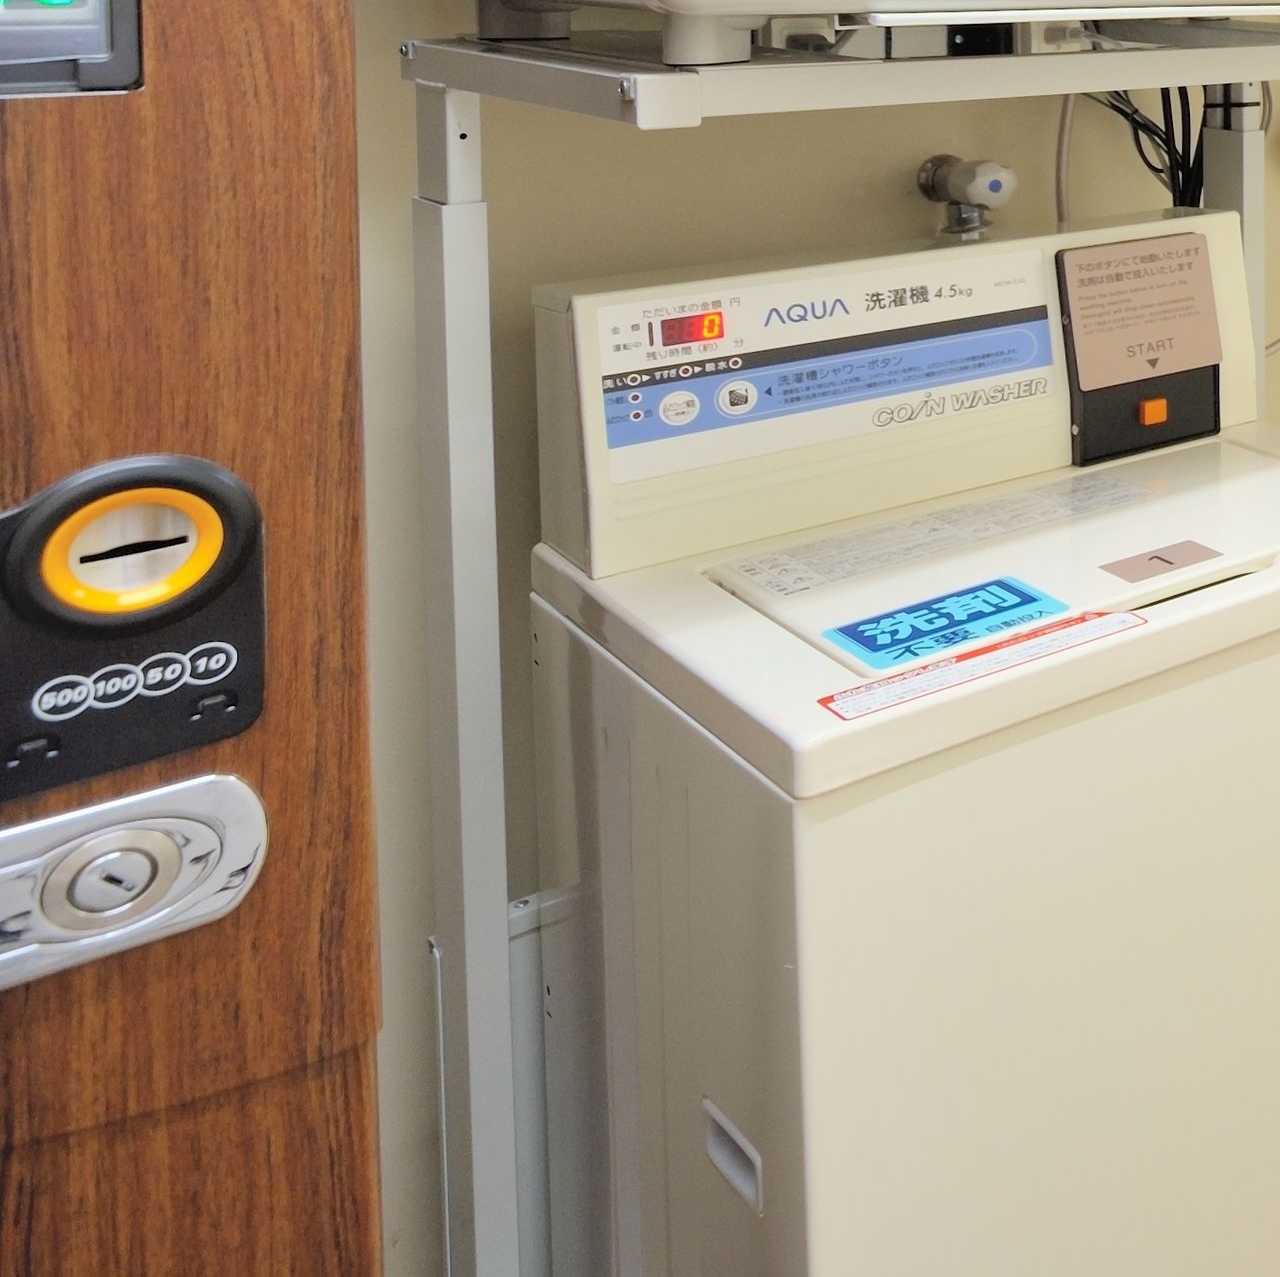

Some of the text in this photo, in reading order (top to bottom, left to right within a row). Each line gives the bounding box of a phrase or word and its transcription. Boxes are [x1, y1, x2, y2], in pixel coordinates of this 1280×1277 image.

[764, 284, 973, 327] AQUA 洗濯機 4.5kg
[703, 314, 720, 338] 0
[1127, 337, 1174, 358] START
[777, 355, 904, 387] 洗濯槽シャワーボタン
[872, 392, 945, 428] COIN
[952, 377, 1047, 411] WASHER
[856, 584, 1023, 646] 洗剤
[884, 627, 981, 660] 不要
[40, 649, 227, 712] 500 100 50 10
